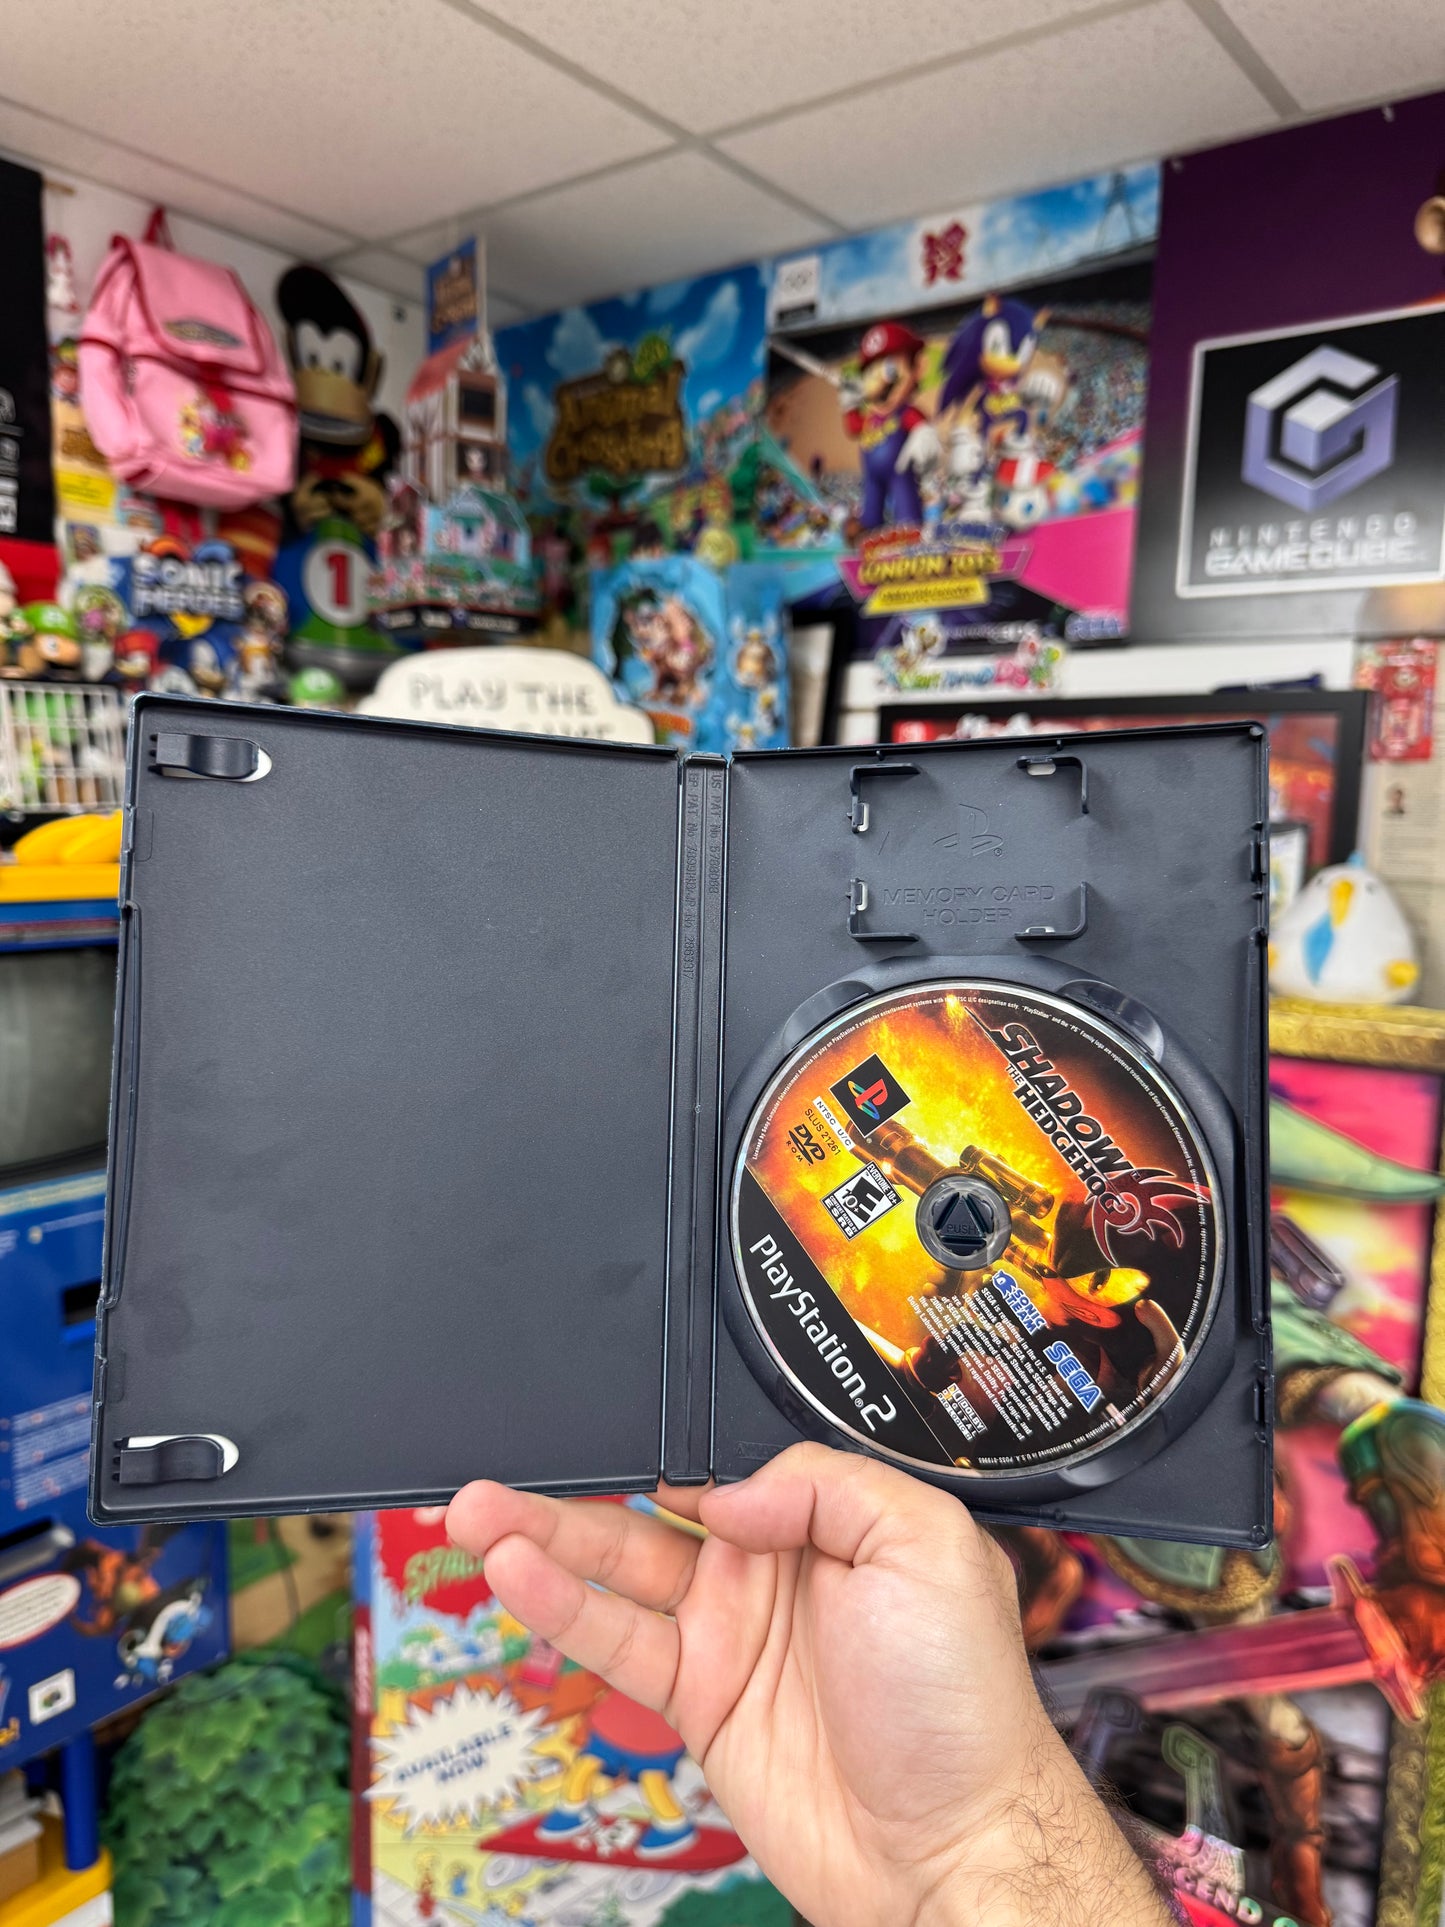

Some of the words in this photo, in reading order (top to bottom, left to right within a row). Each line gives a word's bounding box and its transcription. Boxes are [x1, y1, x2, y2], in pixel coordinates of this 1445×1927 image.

[1209, 511, 1417, 547] NINTENDO
[1204, 537, 1420, 577] GAMECUBE
[408, 672, 506, 711] PLAY
[517, 680, 597, 716] THE
[883, 887, 983, 906] MEMORY
[992, 884, 1055, 903] CARD
[923, 908, 1013, 926] HOLDER
[880, 1002, 912, 1017] entertainment
[912, 998, 932, 1007] systems
[978, 996, 1006, 1007] designation
[1007, 1001, 1019, 1010] only.
[859, 1013, 881, 1027] computer
[1051, 1015, 1060, 1024] and
[1060, 1019, 1068, 1028] the
[831, 1025, 856, 1044] PlayStation
[1079, 1029, 1095, 1043] Family
[1093, 1039, 1105, 1050] logo
[817, 1045, 828, 1055] play
[1102, 1045, 1112, 1056] are
[1109, 1051, 1132, 1072] registered
[797, 1057, 814, 1074] America
[1006, 1064, 1026, 1084] THE
[1128, 1068, 1151, 1092] trademarks
[777, 1072, 800, 1101] Entertainment
[992, 1023, 1137, 1178] SHADOW
[1150, 1094, 1163, 1107] Sony
[761, 1120, 770, 1133] Sony
[816, 1101, 836, 1126] NTSC
[837, 1129, 852, 1147] U/C
[1158, 1105, 1176, 1128] Computer
[794, 1123, 826, 1162] DVD
[805, 1108, 824, 1133] SLUS
[821, 1130, 842, 1156] 21261
[1171, 1126, 1191, 1159] Entertainment
[786, 1139, 803, 1163] ROM
[1013, 1081, 1121, 1215] HEDGEHOG
[866, 1163, 890, 1193] EVERYONE
[886, 1190, 898, 1204] 10+
[824, 1198, 853, 1237] ESRB
[947, 1224, 976, 1235] PUSH
[1005, 1295, 1038, 1335] TEAM
[1014, 1287, 1046, 1328] SONIC
[749, 1234, 867, 1400] PlayStation
[859, 1394, 897, 1432] 2
[905, 1295, 923, 1315] Dolby
[918, 1312, 951, 1353] Laboratories.
[945, 1302, 961, 1321] SEGA
[990, 1363, 1007, 1383] SEGA
[970, 1290, 997, 1323] Trademark
[1023, 1361, 1035, 1374] the
[1031, 1372, 1048, 1391] SEGA
[1056, 1406, 1068, 1419] the
[980, 1287, 996, 1305] SEGA
[997, 1310, 1024, 1343] registered
[1025, 1348, 1037, 1360] the
[1033, 1358, 1048, 1375] U.S.
[1044, 1373, 1063, 1395] Patent
[1059, 1393, 1072, 1407] and
[917, 1295, 929, 1308] the
[925, 1306, 949, 1335] double-D
[944, 1333, 965, 1357] symbol
[960, 1354, 973, 1368] are
[968, 1366, 995, 1399] registered
[990, 1396, 1020, 1432] trademarks
[941, 1313, 953, 1325] All
[948, 1322, 966, 1343] rights
[961, 1340, 986, 1370] reserved.
[997, 1389, 1009, 1402] Pro
[1019, 1420, 1033, 1434] and
[950, 1294, 963, 1307] are
[958, 1305, 976, 1325] either
[971, 1322, 998, 1355] registered
[994, 1353, 1023, 1389] trademarks
[1024, 1395, 1054, 1431] trademarks
[960, 1292, 979, 1314] SONIC
[974, 1311, 992, 1331] TEAM
[999, 1345, 1013, 1360] and
[1008, 1358, 1031, 1384] Shadow
[1026, 1382, 1039, 1395] the
[1033, 1392, 1062, 1426] Hedgehog
[1043, 1341, 1103, 1415] SEGA
[940, 1388, 979, 1437] DIGITAL
[959, 1400, 984, 1430] DOLBY
[1037, 1440, 1072, 1457] Manufactured
